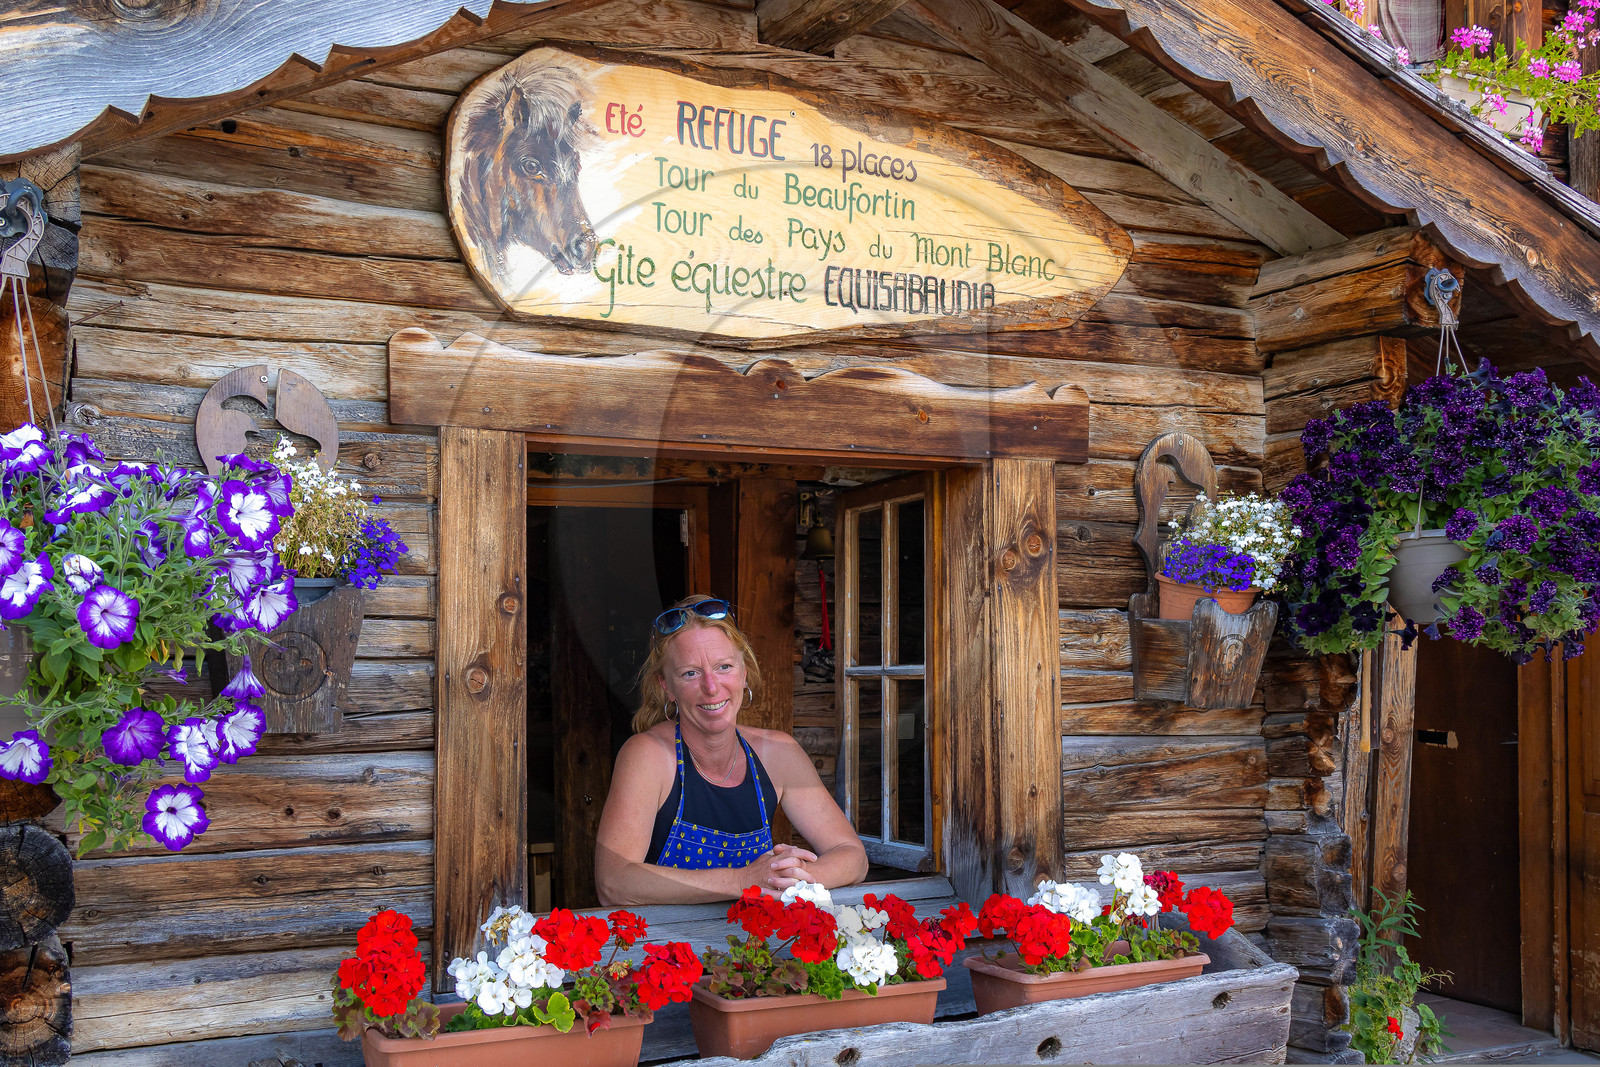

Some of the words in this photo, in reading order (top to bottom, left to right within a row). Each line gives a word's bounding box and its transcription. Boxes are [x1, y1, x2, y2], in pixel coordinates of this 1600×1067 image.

[605, 102, 646, 138] Eté
[677, 100, 787, 161] REFUGE
[811, 142, 834, 170] 18
[841, 141, 918, 183] places
[654, 156, 714, 193] Tour
[734, 173, 759, 200] du
[783, 172, 915, 224] Beaufortin
[652, 202, 712, 237] Tour
[729, 214, 763, 244] des
[787, 217, 846, 261] Pays
[869, 233, 893, 259] du
[986, 242, 1056, 281] Blanc
[671, 249, 807, 314] équestre
[824, 265, 995, 316] EQUISABAUDIA
